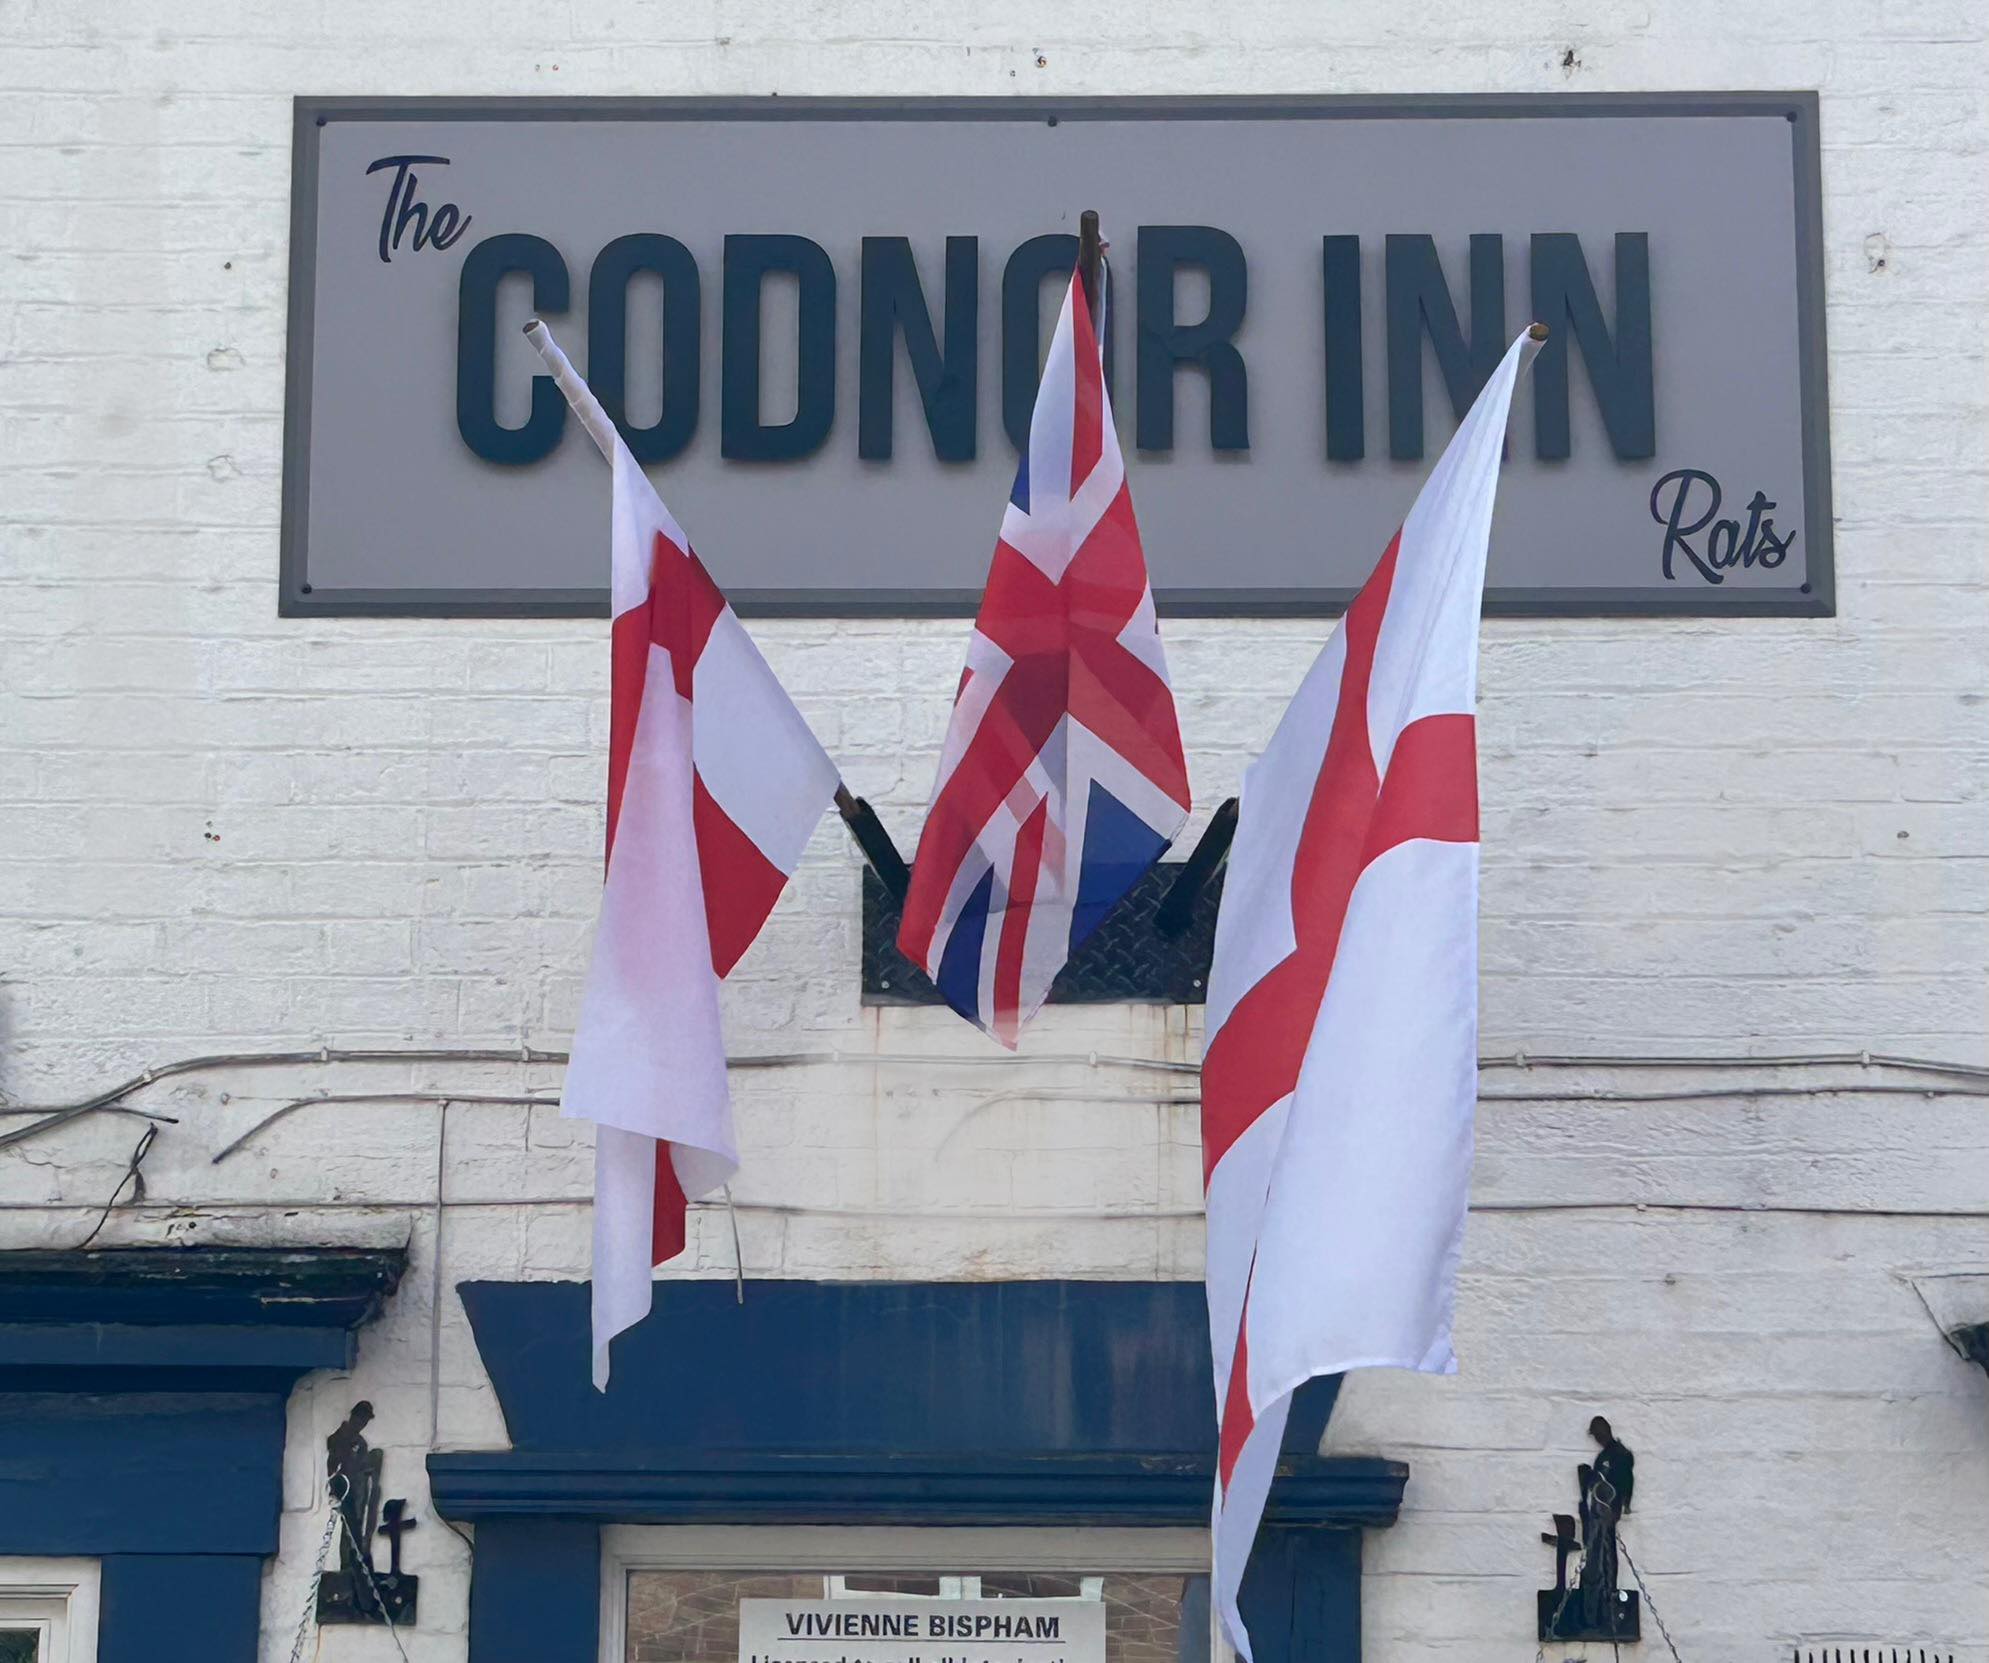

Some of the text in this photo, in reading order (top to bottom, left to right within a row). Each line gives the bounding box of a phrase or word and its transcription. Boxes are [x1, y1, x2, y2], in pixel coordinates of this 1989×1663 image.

[366, 155, 473, 264] The
[1322, 231, 1656, 460] INN
[1650, 468, 1797, 585] Rats
[785, 1612, 1060, 1639] VIVIENNE BISPHAM
